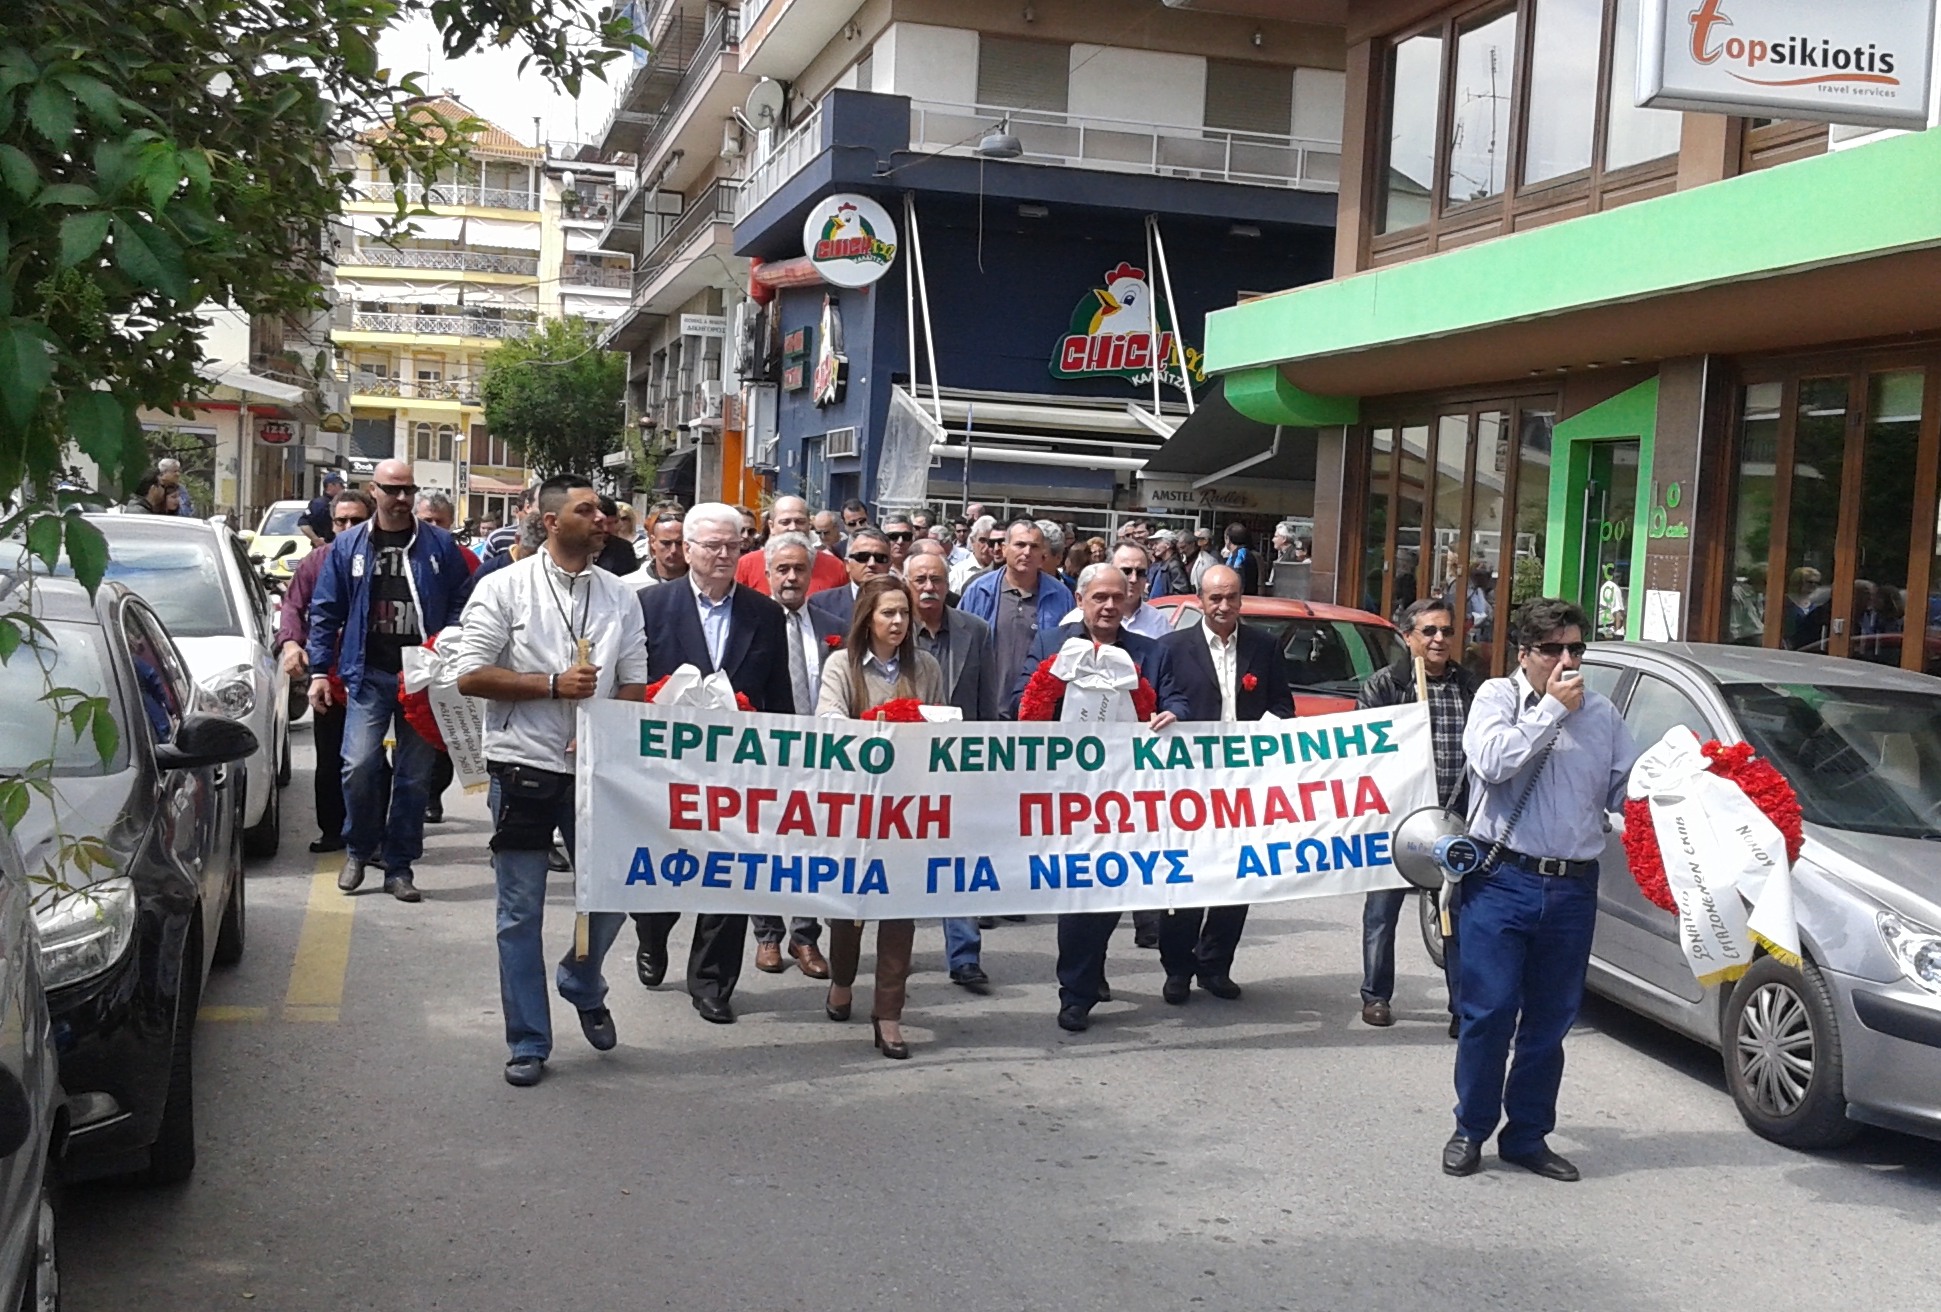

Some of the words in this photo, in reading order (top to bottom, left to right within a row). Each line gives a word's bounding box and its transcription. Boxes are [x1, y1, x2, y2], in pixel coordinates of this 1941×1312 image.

[1687, 0, 1895, 74] topsikiotis
[1818, 84, 1849, 94] travel
[1853, 86, 1896, 98] services
[1152, 490, 1195, 502] AMSTEL
[639, 718, 896, 775] ΕΡΓΑΤΙΚΟ
[928, 735, 1106, 773] ΚΕΝΤΡΟ
[1133, 719, 1399, 770] ΚΑΤΕΡΙΝΗΣ
[668, 782, 952, 840] ΕΡΓΑΤΙΚΗ
[1019, 775, 1391, 836] ΠΡΩΤΟΜΑΓΙΑ
[625, 846, 890, 895] ΑΦΕΤΗΡΙΑ
[926, 856, 1001, 894] ΓΙΑ
[1028, 849, 1194, 890] ΝΕΟΥΣ
[1236, 831, 1395, 879] ΑΓΩΝΕ
